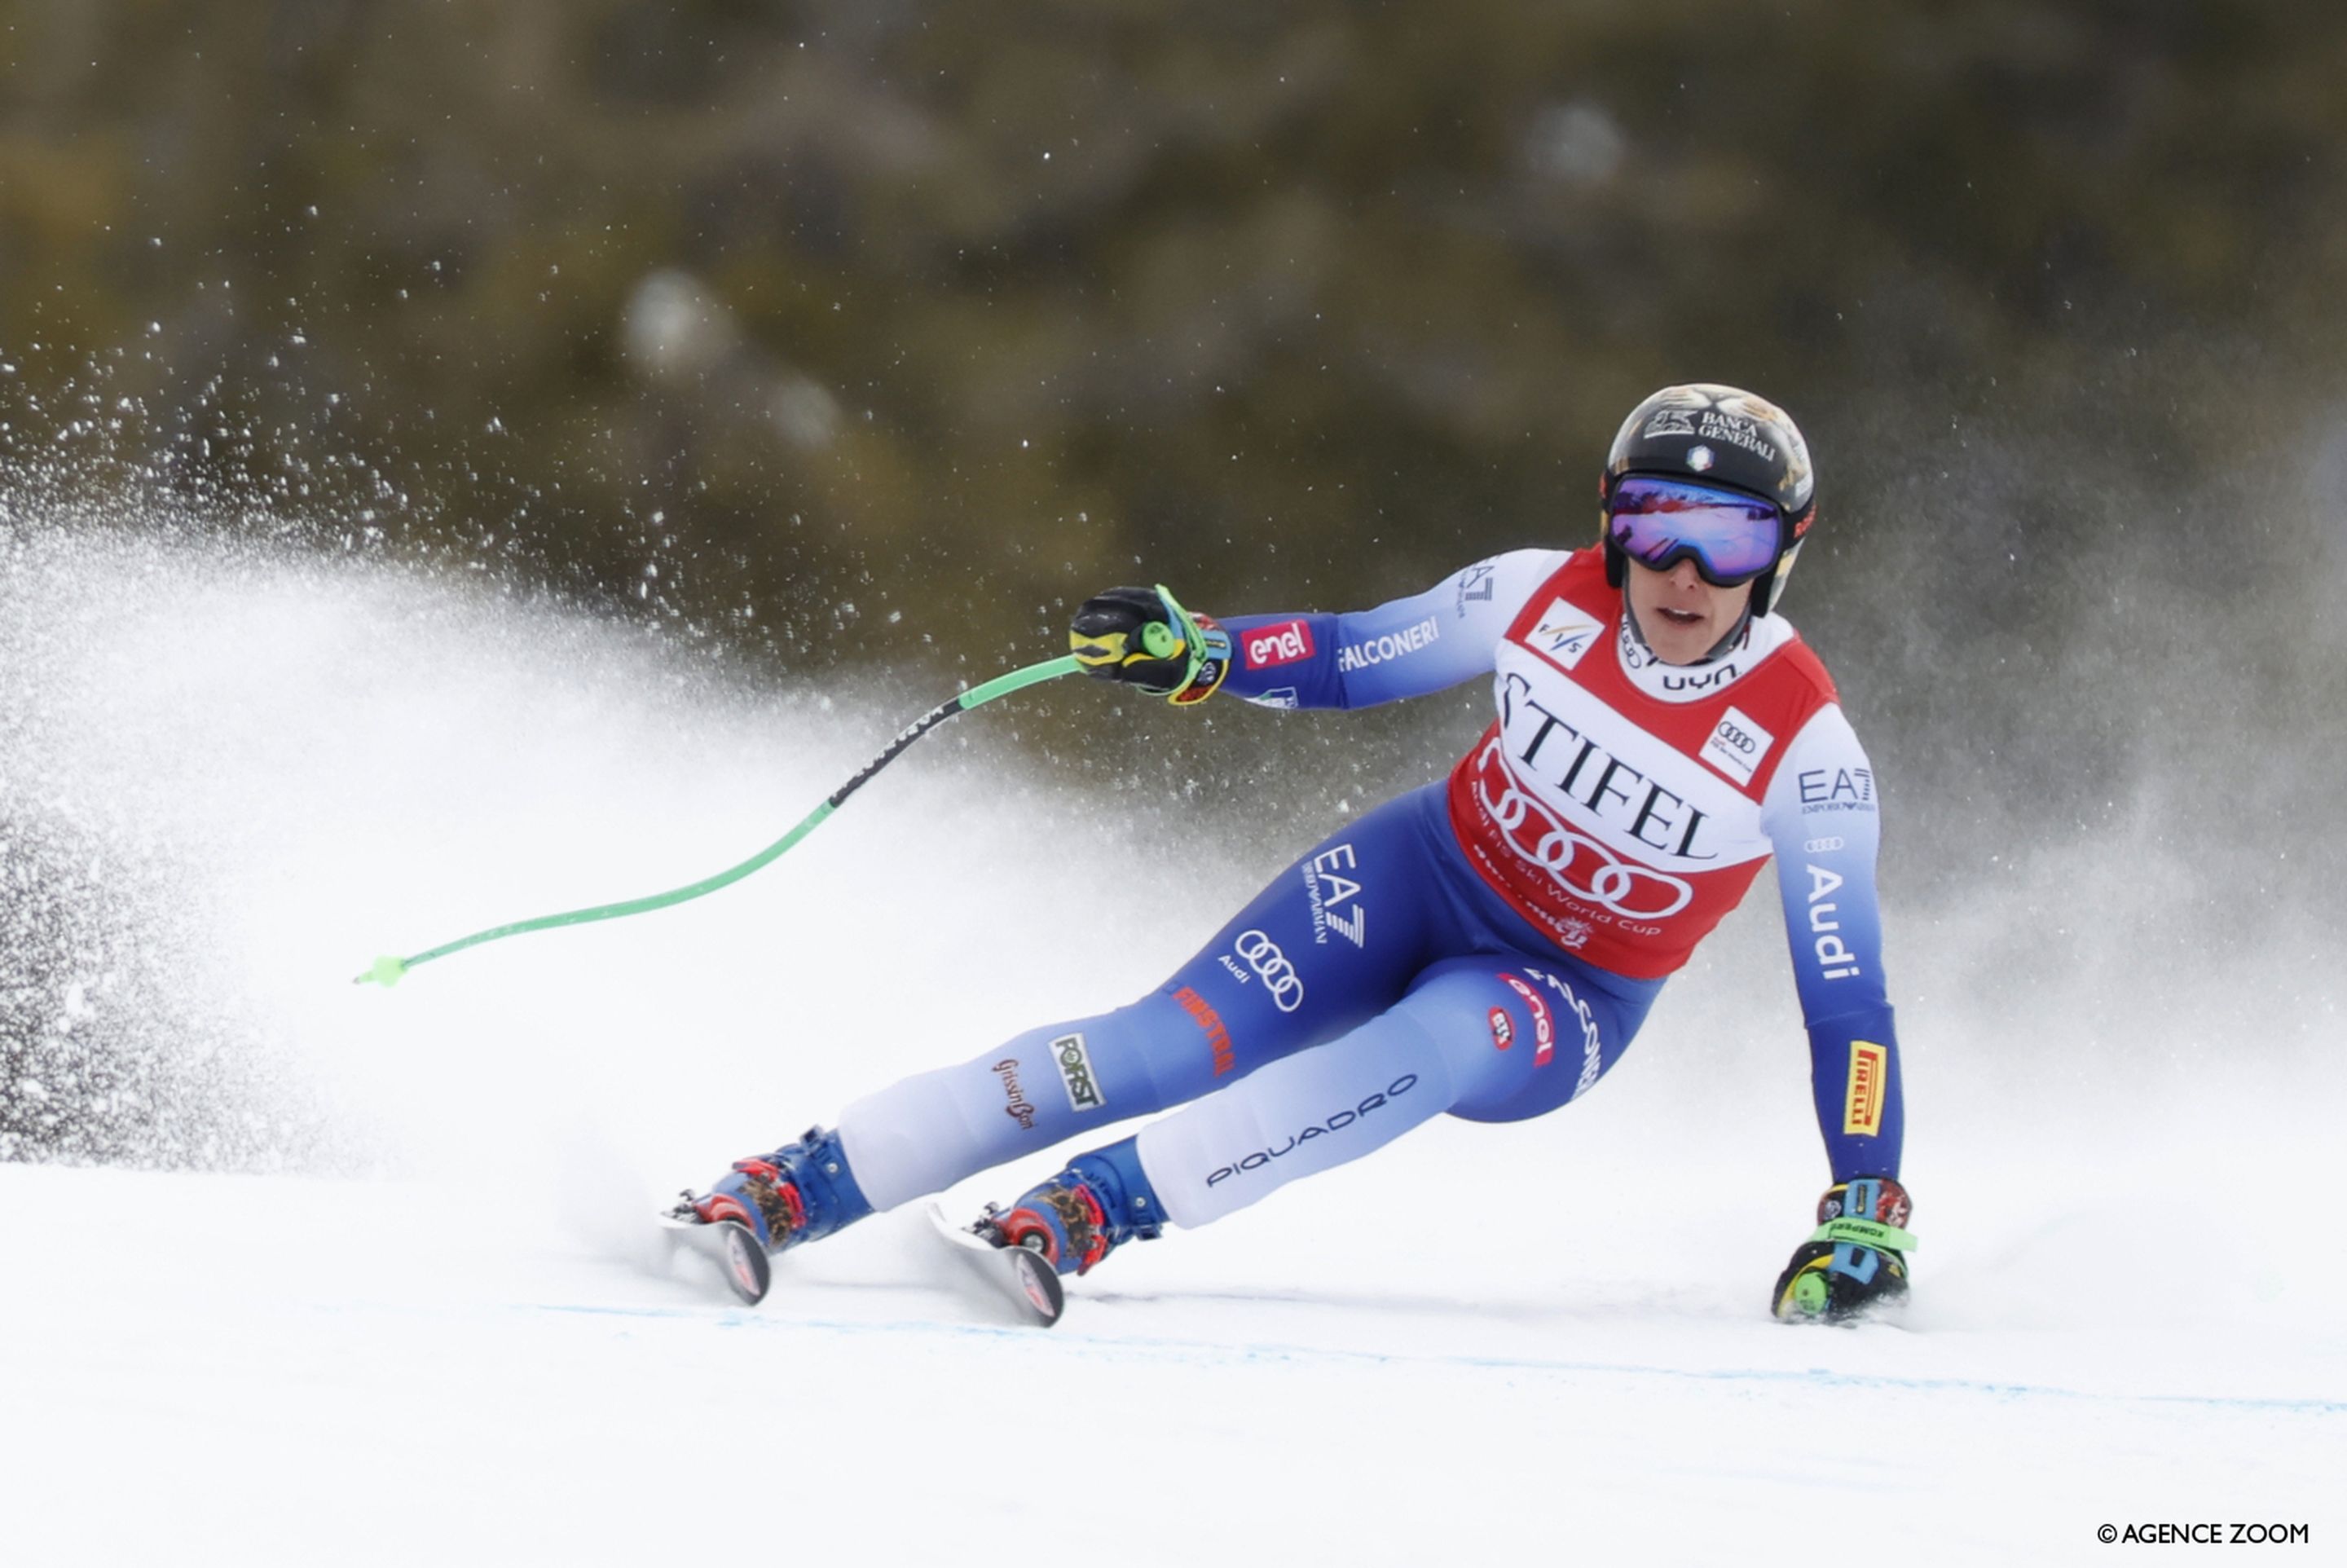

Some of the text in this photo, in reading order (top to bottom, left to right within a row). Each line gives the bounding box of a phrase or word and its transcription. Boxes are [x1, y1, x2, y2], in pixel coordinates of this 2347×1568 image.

[1698, 425, 1776, 462] GENERALI
[1702, 412, 1758, 437] BANCA
[1464, 555, 1500, 603] A7
[1249, 622, 1306, 665] enel
[1337, 615, 1440, 672] FALCONERI
[1538, 623, 1583, 654] FIS
[1504, 673, 1719, 861] STIFEL
[1798, 768, 1872, 804] EA7
[1314, 843, 1365, 949] EA7
[1514, 859, 1543, 885] Ski
[1548, 883, 1612, 924] World
[1617, 921, 1662, 937] Cup
[1806, 863, 1860, 980] Audi
[1218, 954, 1252, 984] Audi
[1508, 977, 1551, 1055] enel
[1055, 1037, 1100, 1107] FORST
[1851, 1048, 1878, 1126] PIRELLI
[1206, 1074, 1418, 1187] PIQUADRO
